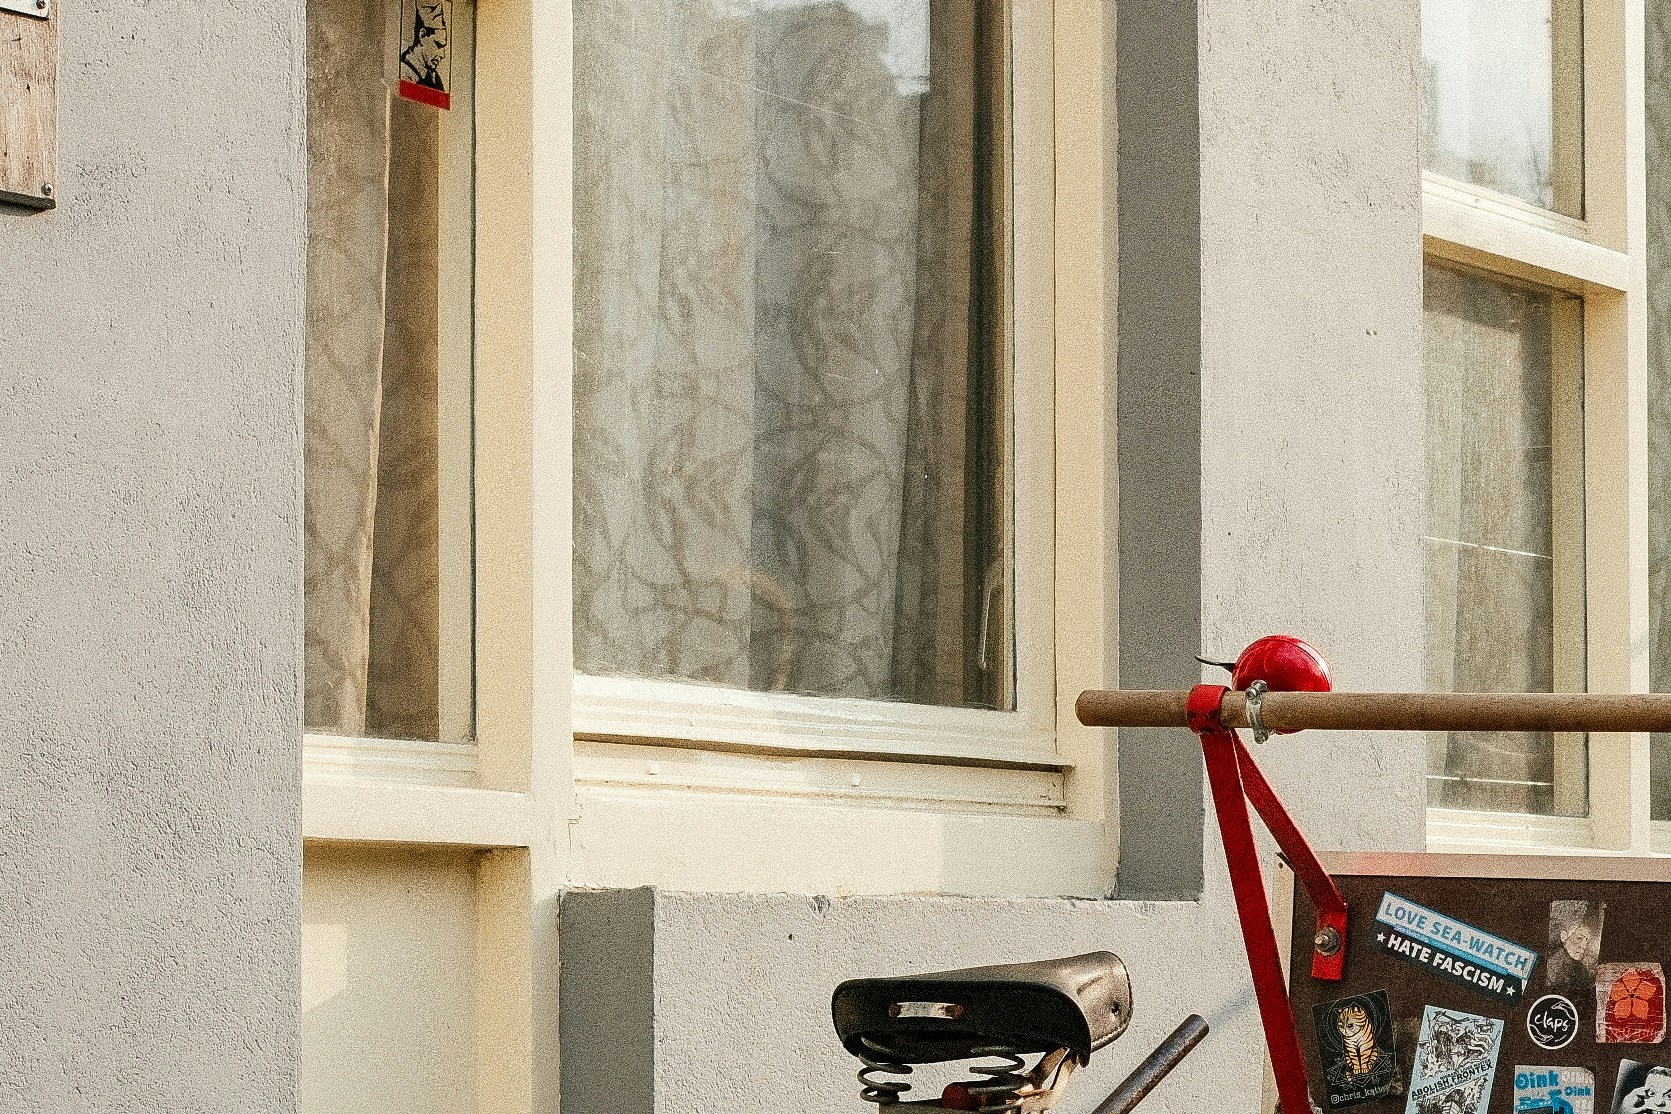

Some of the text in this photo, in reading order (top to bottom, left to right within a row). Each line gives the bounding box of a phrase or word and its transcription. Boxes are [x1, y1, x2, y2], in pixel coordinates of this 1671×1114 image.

[1384, 902, 1529, 972] LOVE SEA-WATCH
[1387, 933, 1505, 993] HATE FASCISM
[1534, 1010, 1571, 1033] claps
[1411, 1062, 1494, 1099] ABOLISH FRONTEX
[1515, 1070, 1560, 1090] Oink
[1565, 1085, 1592, 1096] Oink
